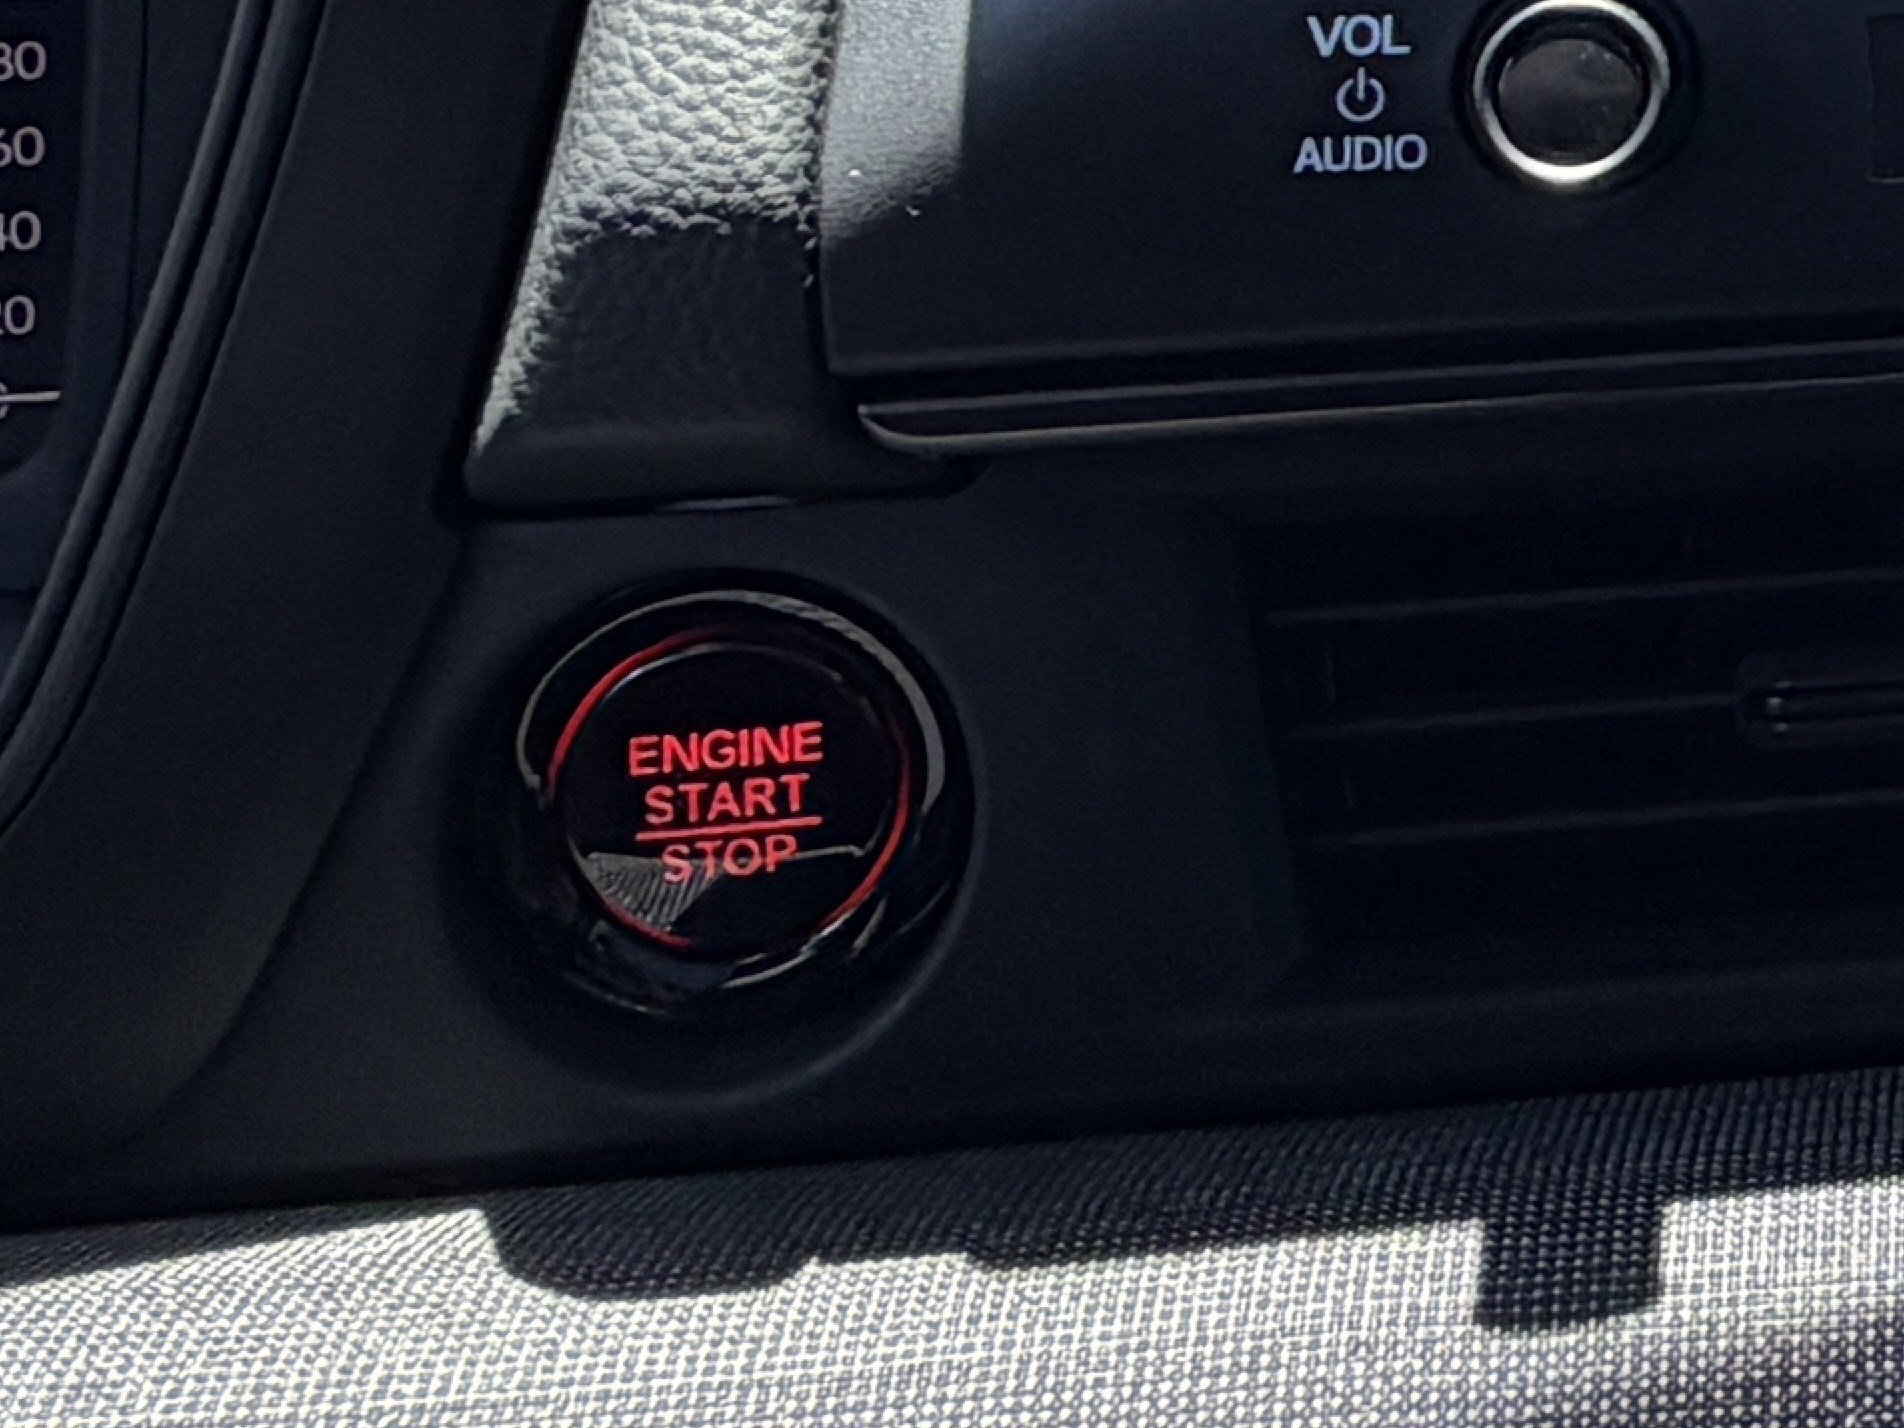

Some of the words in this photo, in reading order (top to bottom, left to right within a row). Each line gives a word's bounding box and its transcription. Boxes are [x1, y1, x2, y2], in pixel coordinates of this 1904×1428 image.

[1306, 14, 1411, 58] VOL
[1293, 134, 1428, 174] AUDIO
[628, 721, 823, 776] ENGINE
[645, 774, 810, 825] START
[662, 834, 798, 882] STOP
